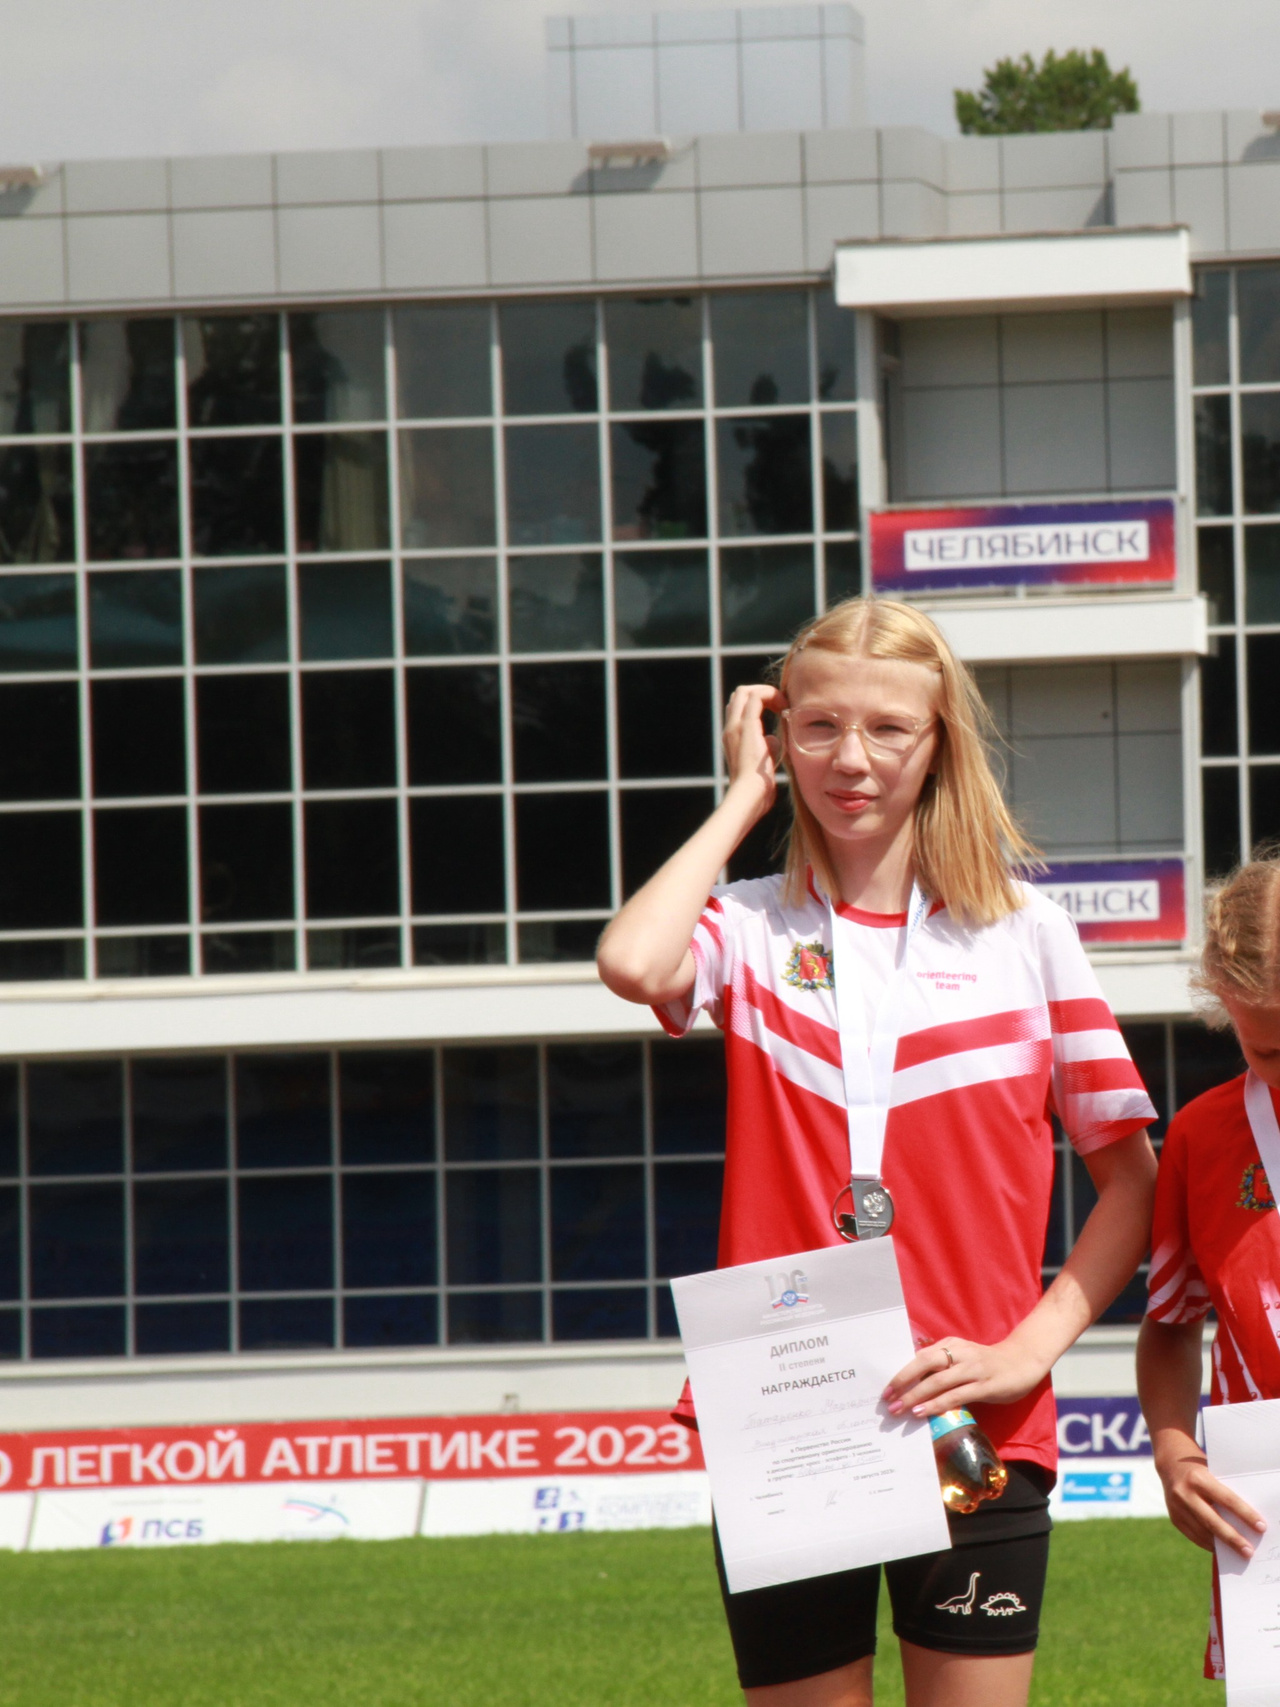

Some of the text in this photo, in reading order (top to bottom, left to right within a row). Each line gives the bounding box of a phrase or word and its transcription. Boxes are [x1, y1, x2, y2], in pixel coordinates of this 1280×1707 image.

[911, 527, 1141, 562] ЧЕЛЯБИНСК
[1047, 887, 1151, 914] ИНСК
[916, 970, 977, 983] orienteering
[935, 980, 960, 991] team
[770, 1335, 829, 1360] ДИПЛОМ
[788, 1356, 826, 1371] степени
[761, 1368, 857, 1396] НАГРАЖДАЕТСЯ
[27, 1429, 246, 1487] ЛЕГКОЙ
[261, 1428, 540, 1476] АТЛЕТИКЕ
[553, 1424, 691, 1468] 2023
[141, 1519, 204, 1539] ПСБ
